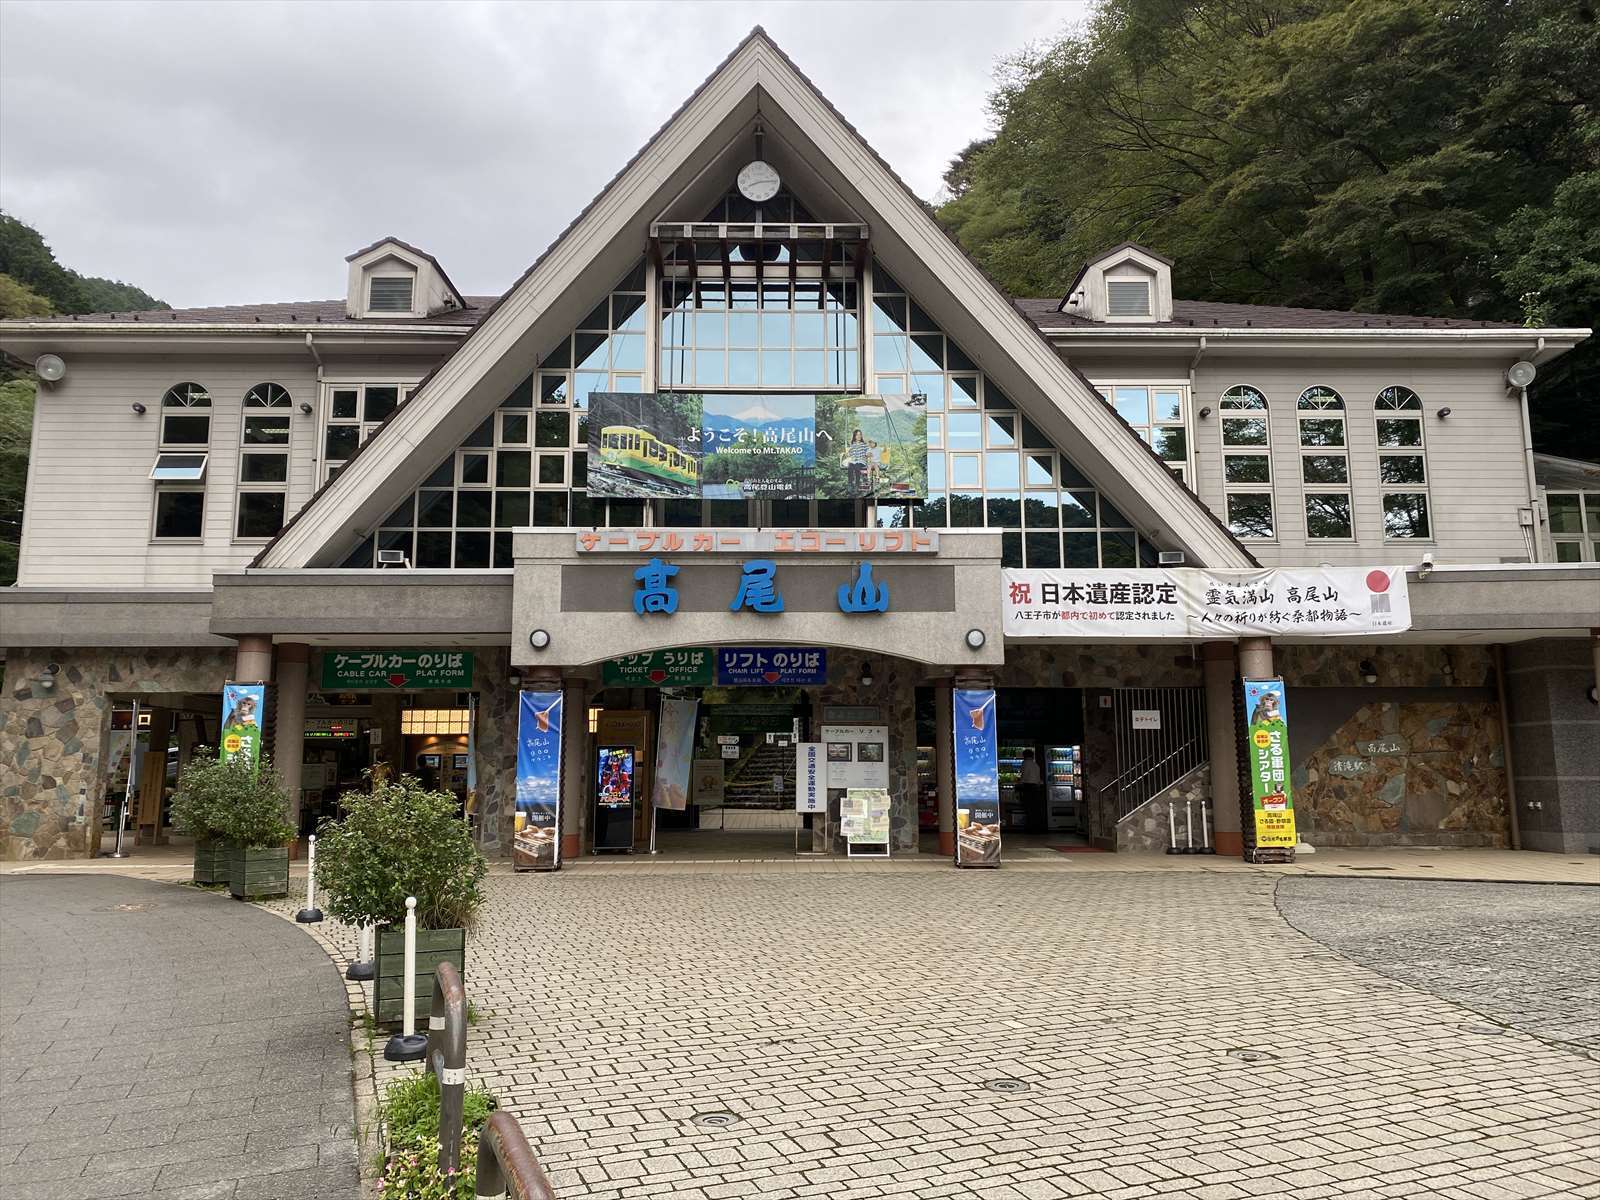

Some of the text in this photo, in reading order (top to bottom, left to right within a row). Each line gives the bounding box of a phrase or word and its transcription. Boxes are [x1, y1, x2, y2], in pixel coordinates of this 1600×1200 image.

[716, 446, 803, 455] Welcome to Mt.TAKAO
[580, 531, 741, 552] ケーブルカー
[1009, 581, 1178, 605] 祝 日本遺産認定
[1205, 586, 1339, 606] 霊気満山 高尾山
[1014, 610, 1175, 621] 八王子市が都内で初めて認定されました
[334, 653, 464, 668] ケーブルカーのりば
[663, 652, 704, 665] うりば
[724, 653, 820, 668] リフト のりば
[416, 669, 436, 677] PLAT
[440, 669, 464, 677] FORM
[1366, 743, 1401, 753] 高尾山
[1270, 730, 1285, 782] さる軍団
[1258, 749, 1271, 793] シアター
